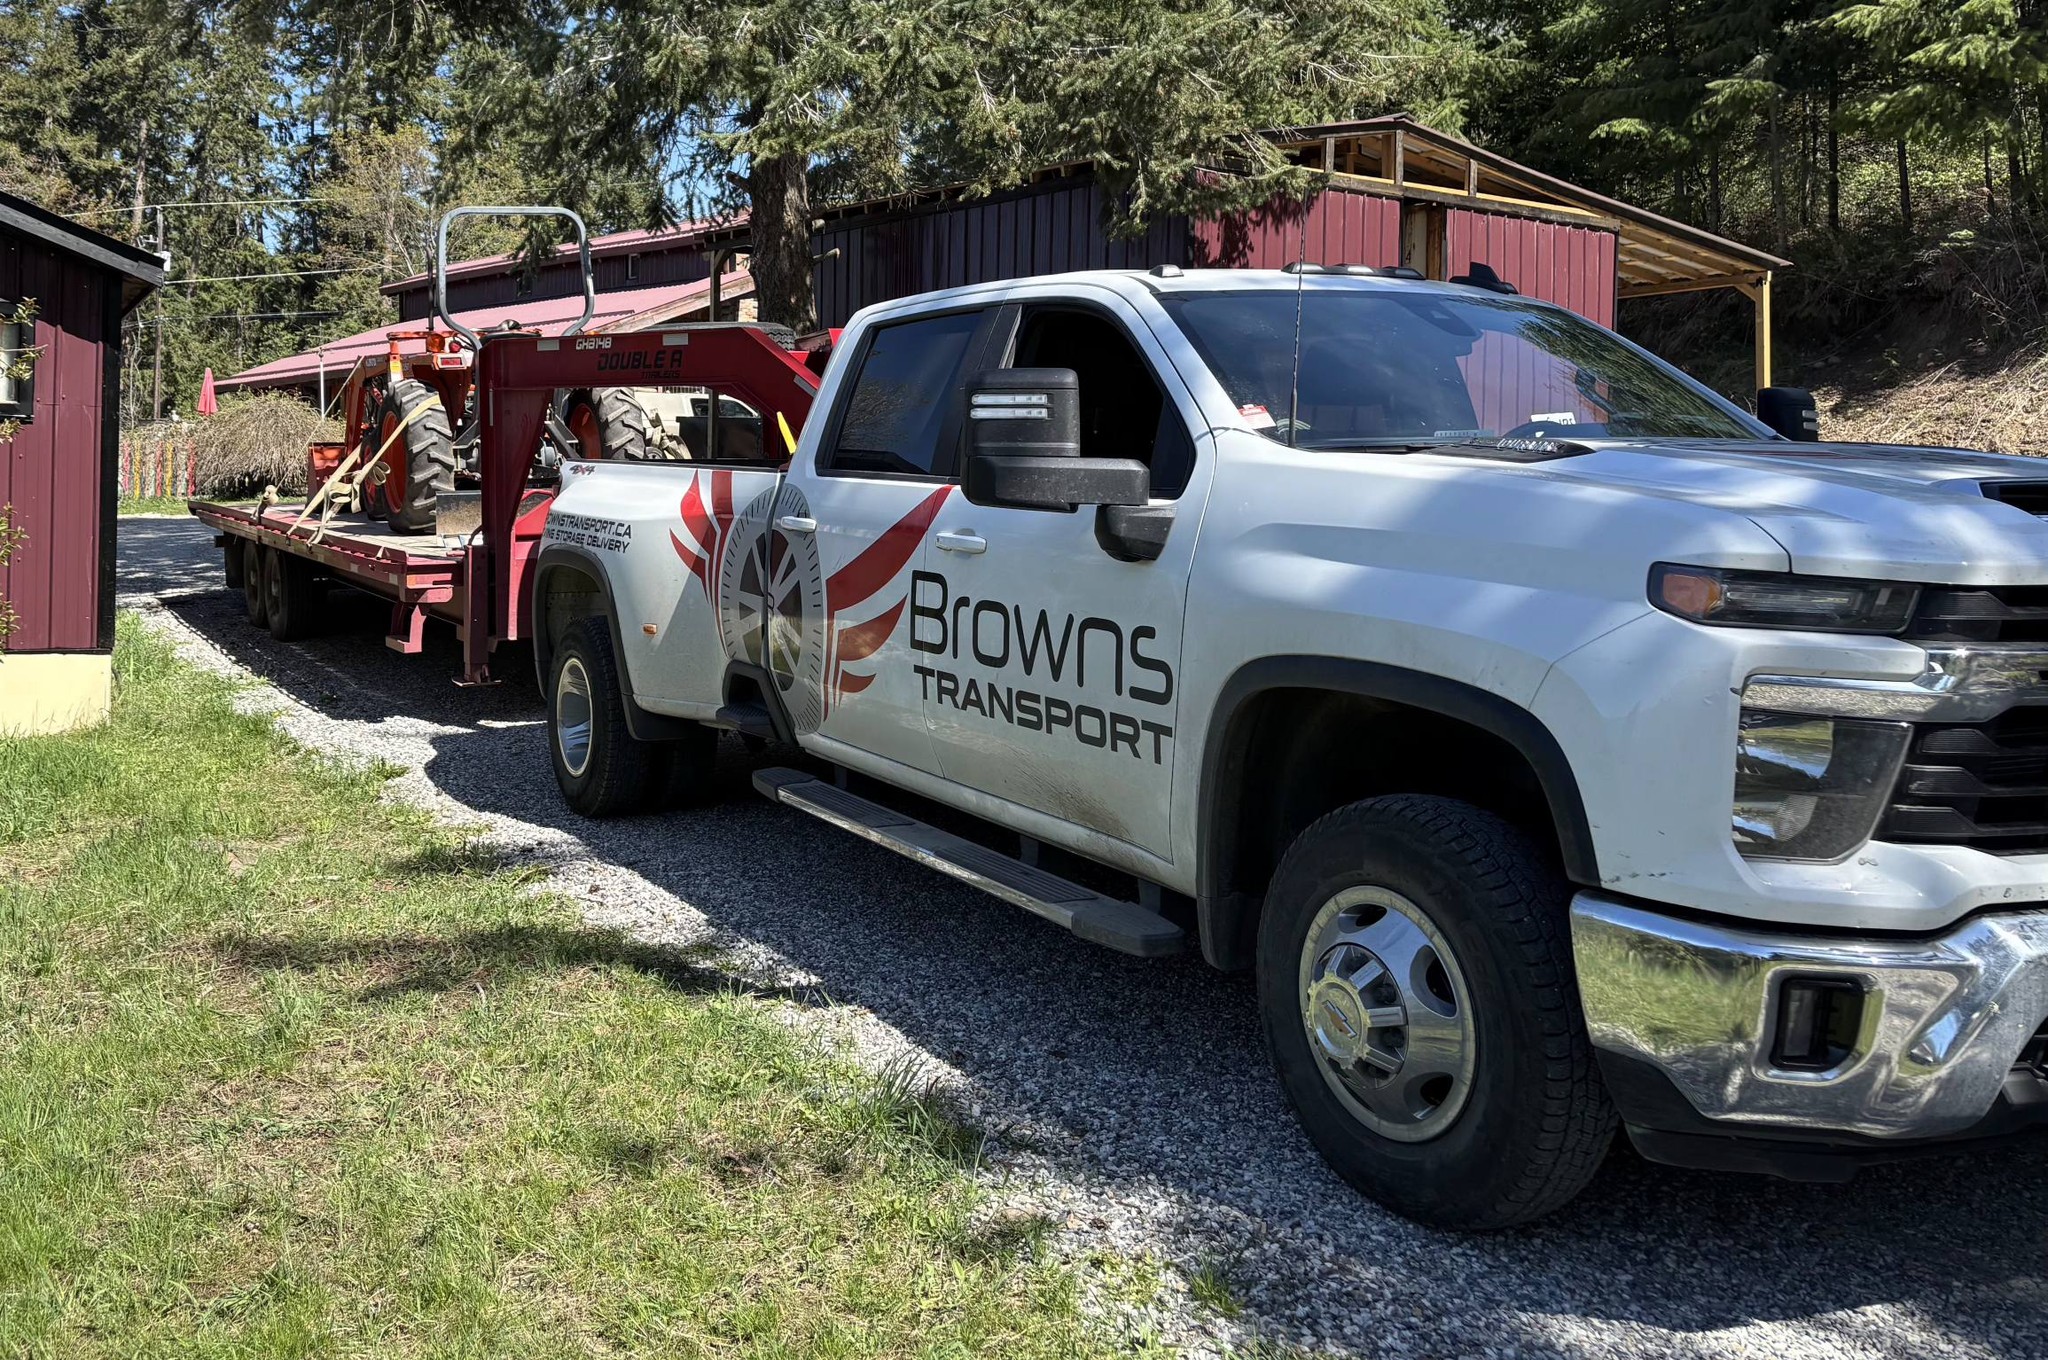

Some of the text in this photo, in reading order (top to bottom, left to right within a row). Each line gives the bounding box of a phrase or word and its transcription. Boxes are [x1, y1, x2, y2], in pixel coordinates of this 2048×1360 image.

[598, 349, 683, 371] DOUBLE A
[555, 530, 586, 546] STORAGE
[586, 534, 630, 553] DELIVERY
[913, 664, 1173, 765] TRANSPORT
